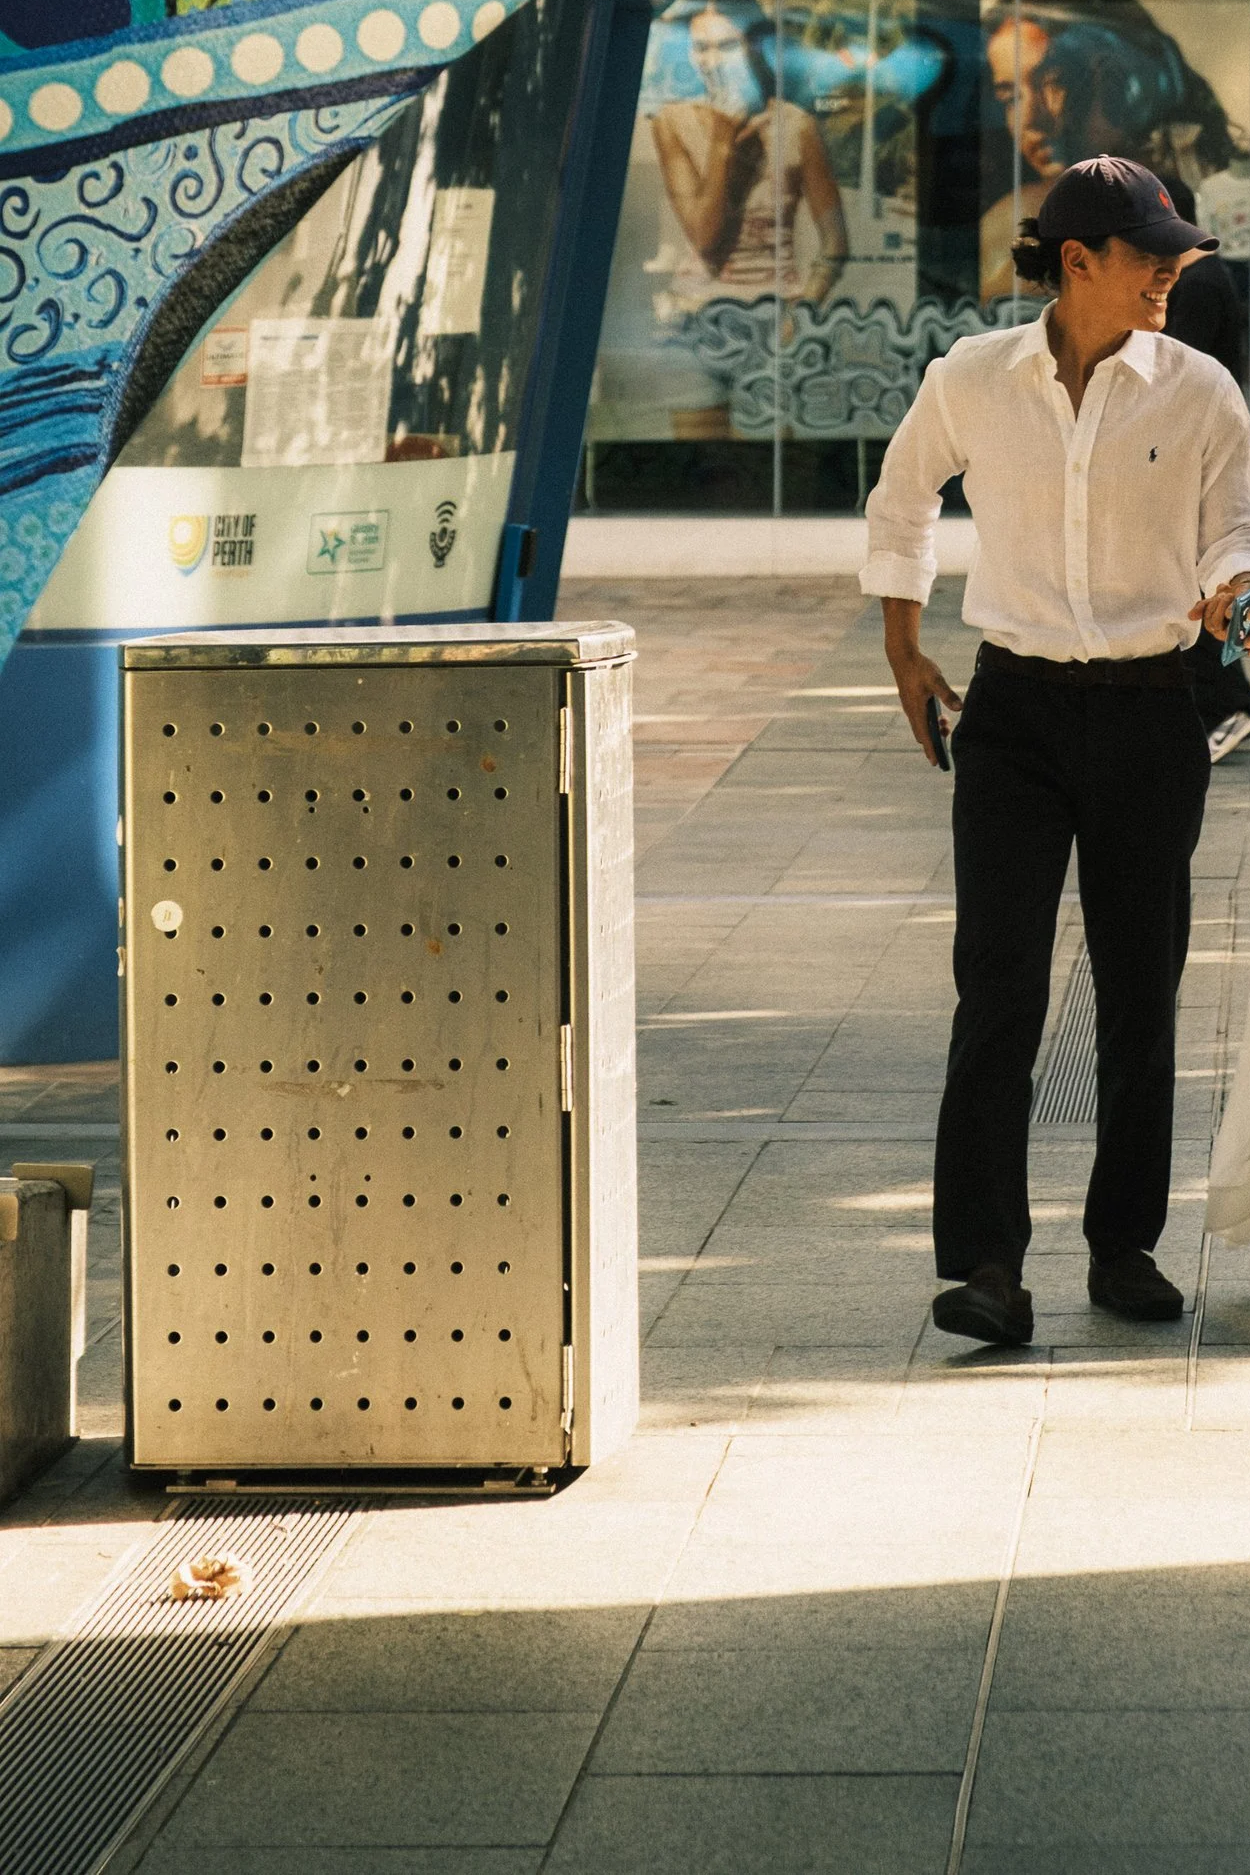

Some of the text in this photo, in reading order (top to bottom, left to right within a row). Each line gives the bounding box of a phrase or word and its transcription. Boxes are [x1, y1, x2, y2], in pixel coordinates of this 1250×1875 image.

[214, 514, 256, 537] CITY OF
[212, 540, 254, 566] PERTH
